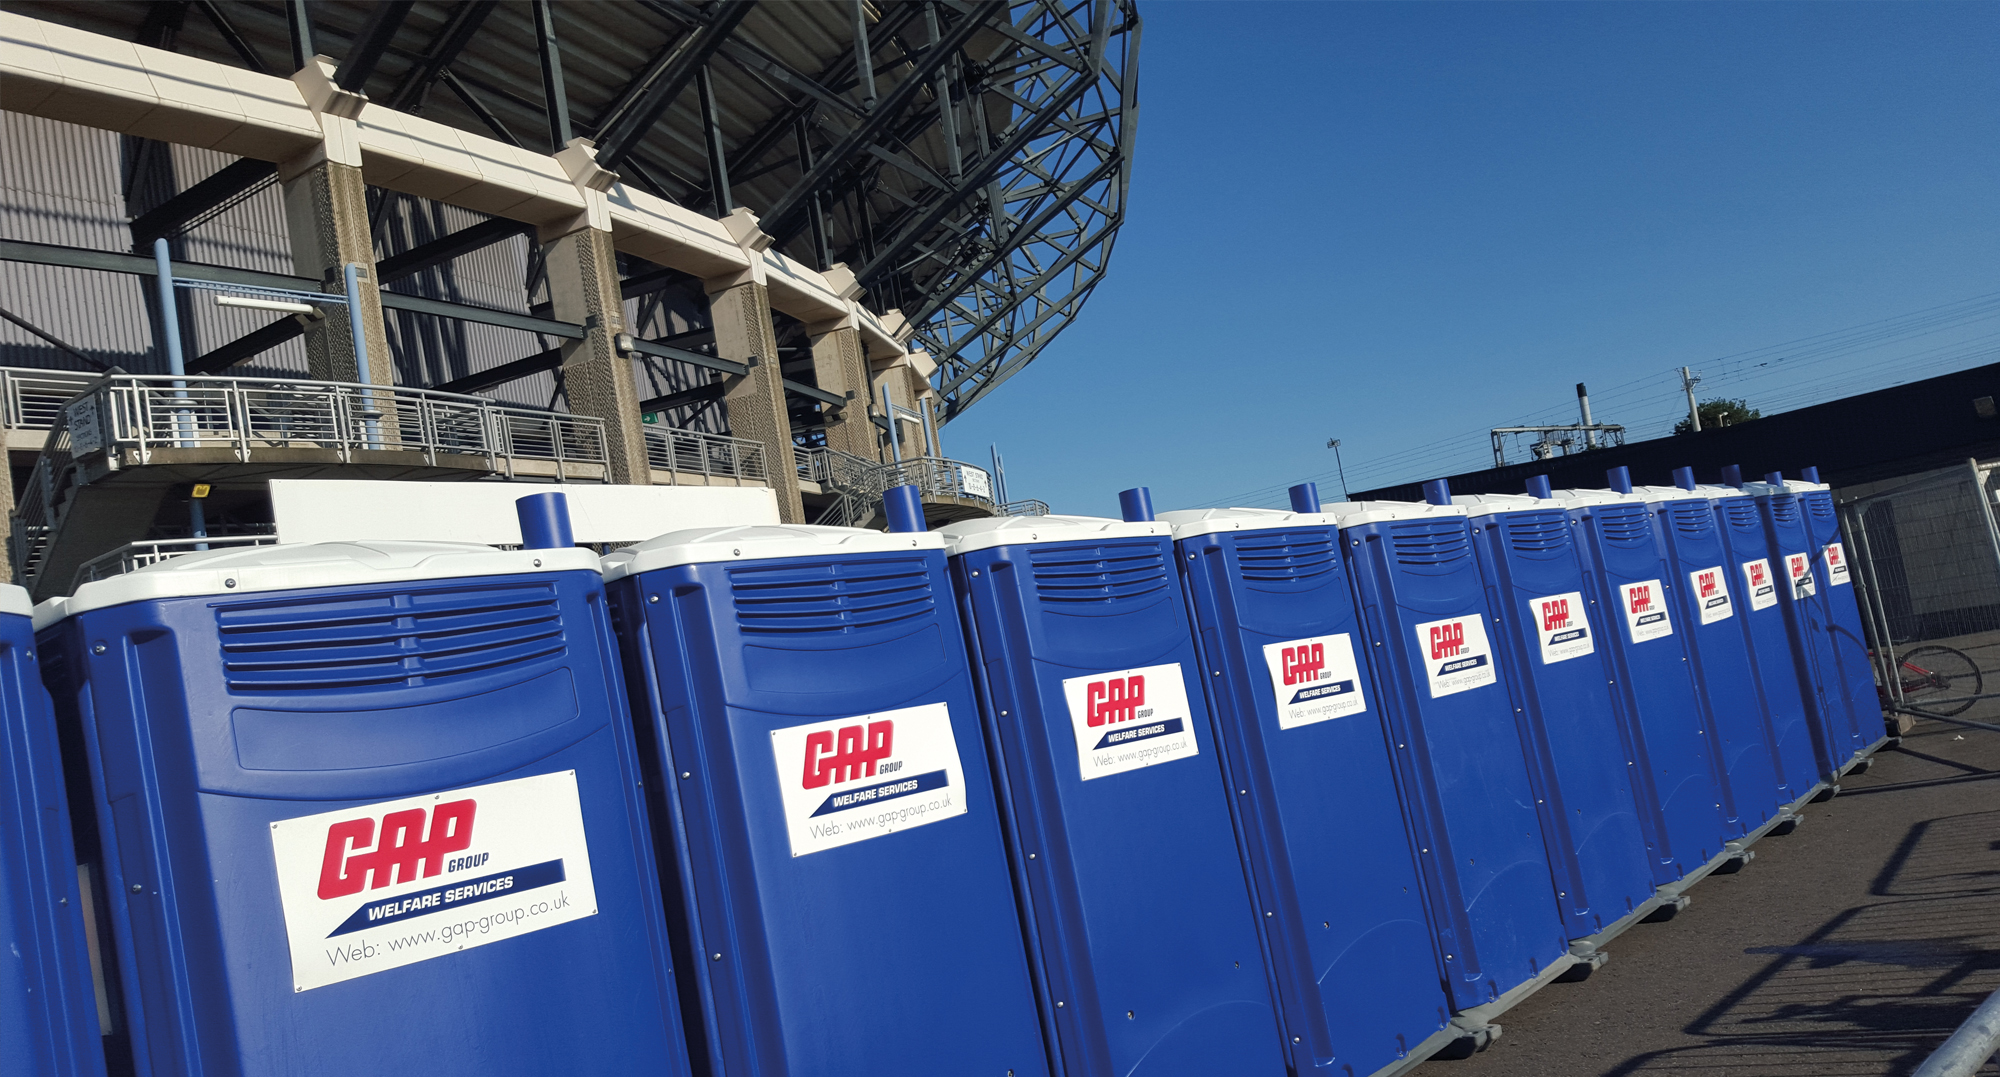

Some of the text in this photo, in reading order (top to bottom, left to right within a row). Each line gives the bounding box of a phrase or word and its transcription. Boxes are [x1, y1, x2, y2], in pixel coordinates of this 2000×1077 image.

[1630, 585, 1651, 614] GAP
[1699, 572, 1716, 598] GAP
[1542, 599, 1569, 631] GAP
[1430, 622, 1464, 660] GAP
[1282, 643, 1331, 686] GAP GROUP
[1087, 675, 1153, 727] GAP GROUP
[1299, 685, 1341, 699] WELFARE SERVICES
[1288, 708, 1306, 719] Web:
[1108, 724, 1165, 743] WELFARE SERVICES
[802, 719, 903, 789] GAP GROUP
[1093, 738, 1187, 767] Web: www.gap-group.co.uk
[833, 780, 918, 807] WELFARE SERVICES
[810, 794, 952, 838] Web: www.gap-group.co.uk
[317, 798, 489, 900] GAP GROUP
[368, 876, 514, 920] WELFARE SERVICES
[326, 891, 570, 966] Web: www.gap-group.co.uk
